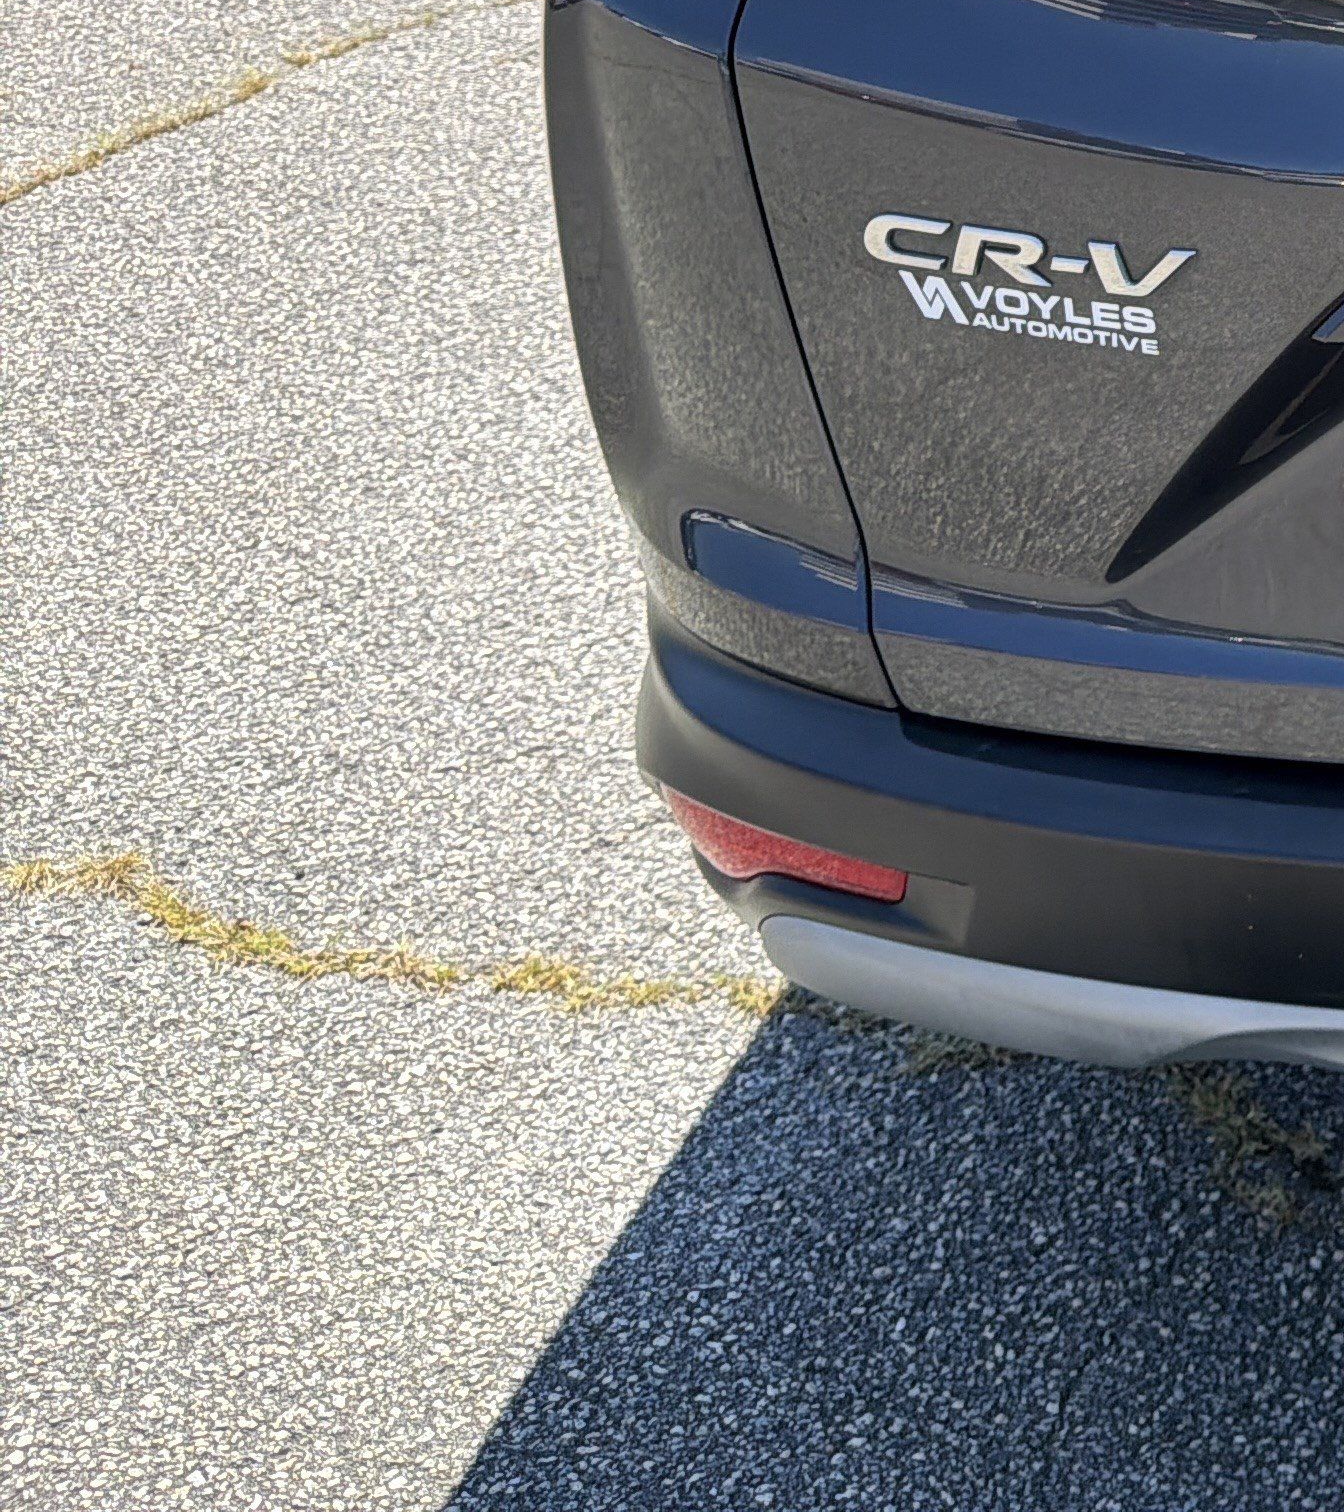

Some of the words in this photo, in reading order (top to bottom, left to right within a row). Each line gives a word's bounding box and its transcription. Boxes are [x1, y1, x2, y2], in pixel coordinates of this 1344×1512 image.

[863, 211, 1198, 297] CR-V
[960, 280, 1157, 334] VOYLES
[971, 312, 1160, 356] AUTOMOTIVE
